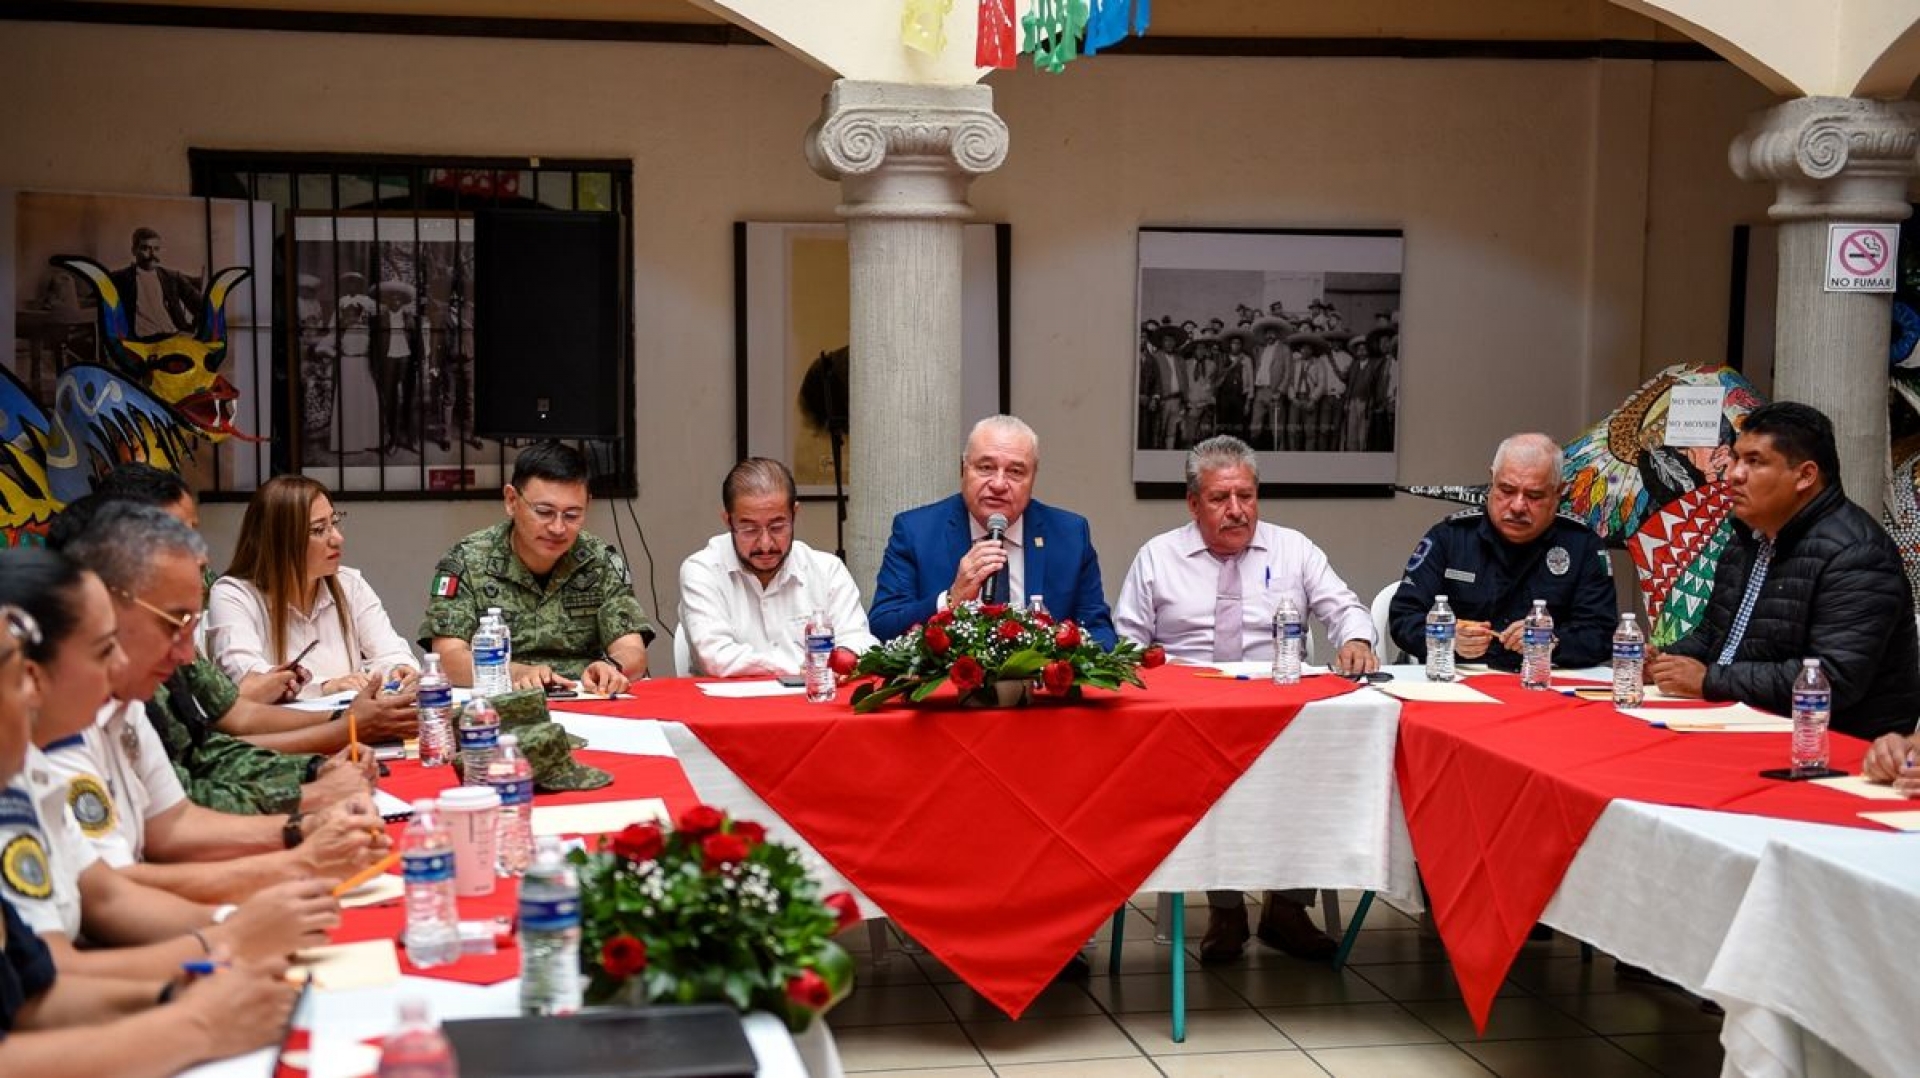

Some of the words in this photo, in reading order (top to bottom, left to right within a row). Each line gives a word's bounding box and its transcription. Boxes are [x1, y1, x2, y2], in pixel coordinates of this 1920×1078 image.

[1831, 277, 1850, 287] NO
[1854, 277, 1891, 287] FUMAR
[1671, 397, 1685, 405] NO
[1688, 397, 1718, 405] TOCAR
[1669, 420, 1681, 428] NO
[1684, 420, 1718, 428] MOVER
